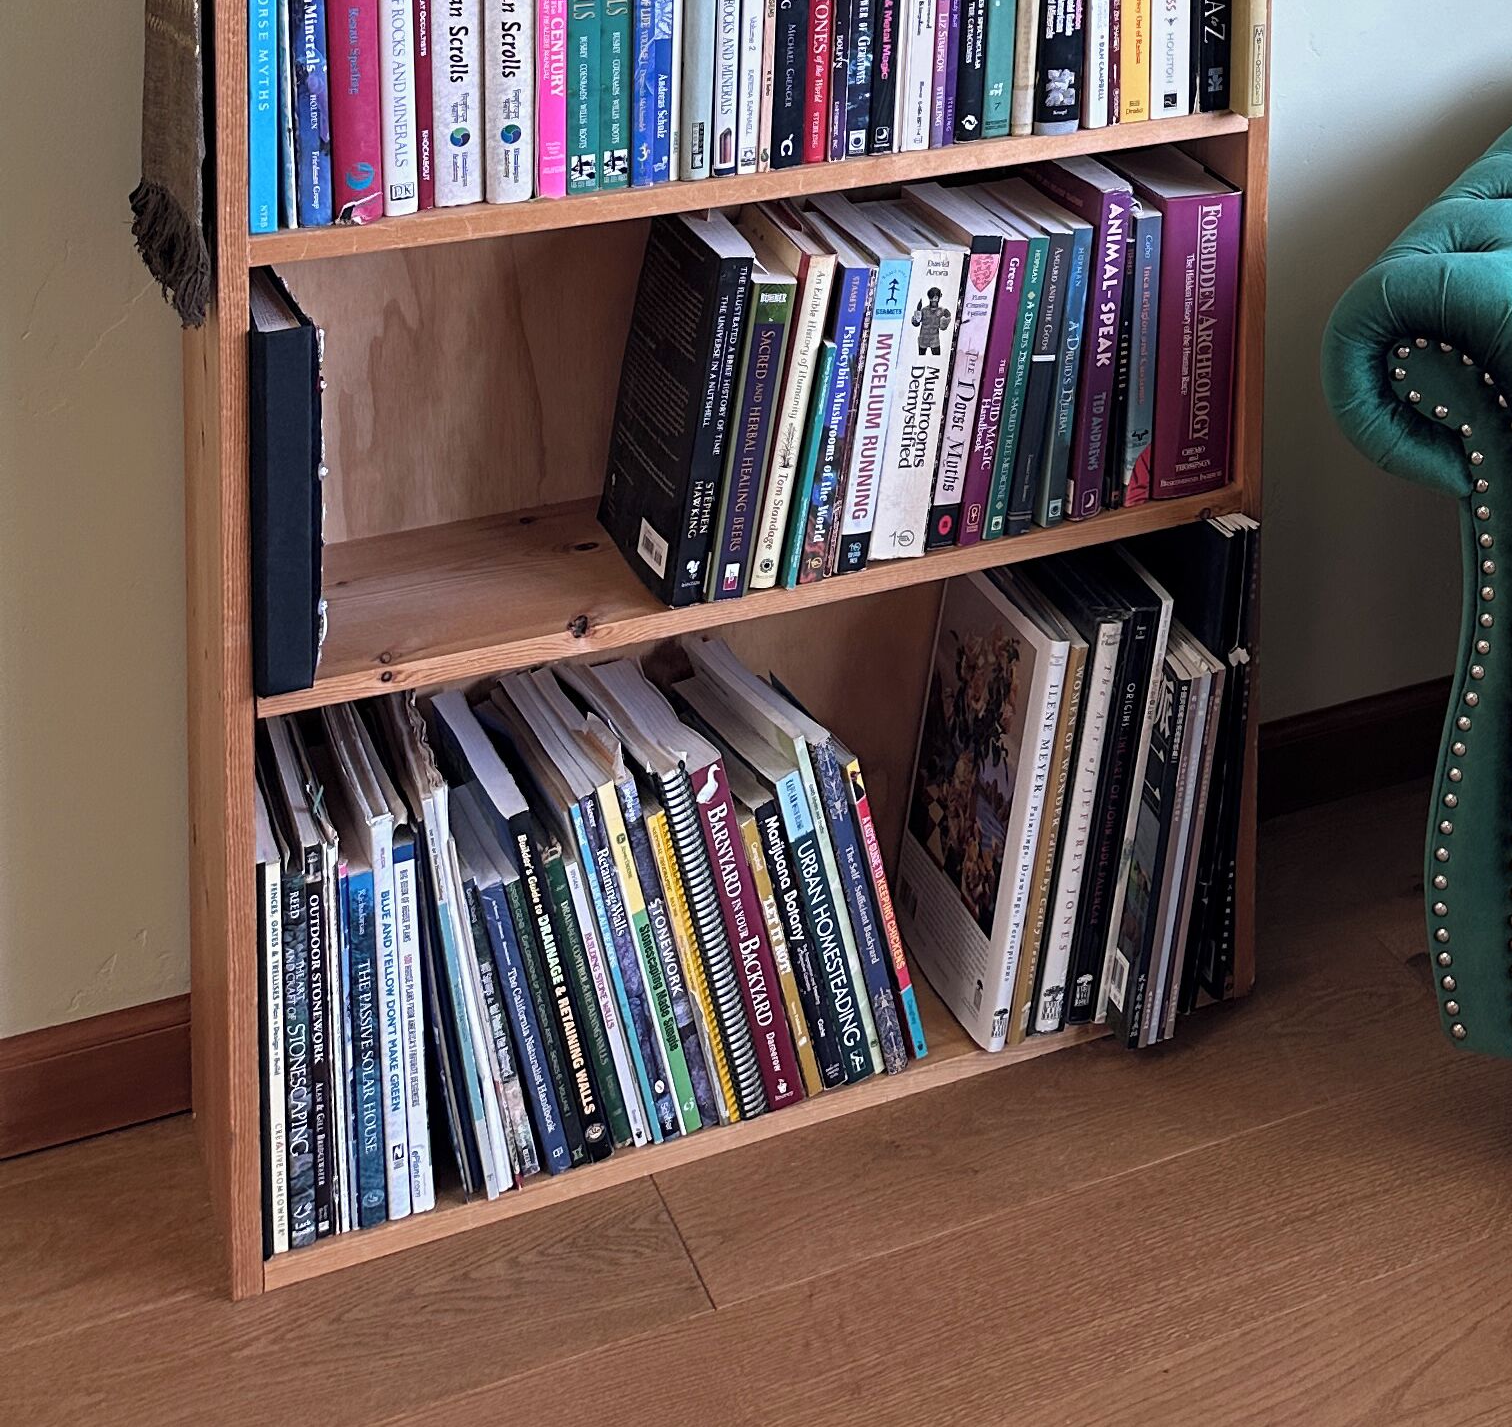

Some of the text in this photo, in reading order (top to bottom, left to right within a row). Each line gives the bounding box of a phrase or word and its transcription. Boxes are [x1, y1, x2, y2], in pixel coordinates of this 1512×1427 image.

[303, 3, 321, 73] Minerals
[391, 6, 407, 57] ROCKS
[881, 9, 893, 45] Metal
[883, 0, 894, 9] &
[939, 12, 949, 27] LIZ
[1203, 24, 1226, 44] Z
[1204, 0, 1226, 18] A
[257, 49, 270, 111] MYTHS
[392, 61, 407, 93] AND
[449, 25, 469, 83] Scrolls
[501, 21, 522, 79] Scrolls
[550, 18, 565, 97] CENTURY
[721, 37, 735, 62] AND
[879, 45, 893, 81] Magic
[1166, 32, 1175, 84] HOUSTON
[657, 73, 669, 139] Andreas Schulz
[720, 64, 734, 115] MINERALS
[393, 94, 409, 169] MINERALS
[1004, 257, 1020, 294] Greer
[1095, 202, 1125, 368] ANIMAL-SPEAK
[1186, 253, 1195, 268] The
[701, 294, 729, 428] THE NUTSHELL
[711, 265, 748, 456] THE HISTORY OF TIME
[788, 270, 827, 419] An Edible Humanity
[1192, 203, 1222, 441] FORBIDDEN ARCHEOLOGY
[729, 330, 776, 552] SACRED AND HERBAL HEALING BEERS
[812, 325, 857, 543] Psilocybin Mushrooms of the World
[851, 332, 894, 521] MYCELIUM RUNNING
[897, 365, 926, 470] Demystified
[912, 365, 941, 468] Mushrooms
[980, 377, 1006, 471] DRUID MAGIC
[1087, 391, 1107, 471] TED ANDREWS
[687, 480, 705, 540] HAWKING
[699, 481, 715, 534] STEPHEN
[765, 472, 789, 551] Tom Standage
[1045, 682, 1059, 733] ILENE
[1050, 663, 1085, 827] WOMEN OF WONDER
[1056, 663, 1113, 953] The Art of JEFFREY JONES
[287, 890, 299, 919] REED
[380, 890, 391, 920] BLUE
[593, 846, 629, 937] Retaining Walls
[707, 801, 774, 1028] BARNYARD IN YOUR BACKYARD
[763, 815, 805, 942] Marijuana Botany
[842, 844, 881, 964] The Self Sufficient Backyard
[381, 921, 394, 948] AND
[647, 896, 685, 997] STONEWORK
[768, 923, 784, 941] IT
[795, 840, 826, 904] URBAN
[811, 905, 861, 1047] HOMESTEADING
[875, 877, 906, 970] KEEPING CHICKENS
[308, 893, 324, 1064] OUTDOOR STONEWORK
[383, 950, 396, 997] YELLOW
[514, 833, 596, 1115] Builder's Guide to DRAINAGE & RETAINING WALLS
[583, 931, 615, 1030] BUILDING STONE WALLS
[636, 923, 681, 1052] Stonescaping Made Simple
[286, 1022, 309, 1156] STONESCAPING
[358, 958, 378, 1155] THE PASSIVE SOLAR HOUSE
[388, 1038, 400, 1072] MAKE
[505, 967, 557, 1133] The California Naturalist Handbook
[390, 1073, 402, 1113] GREEN
